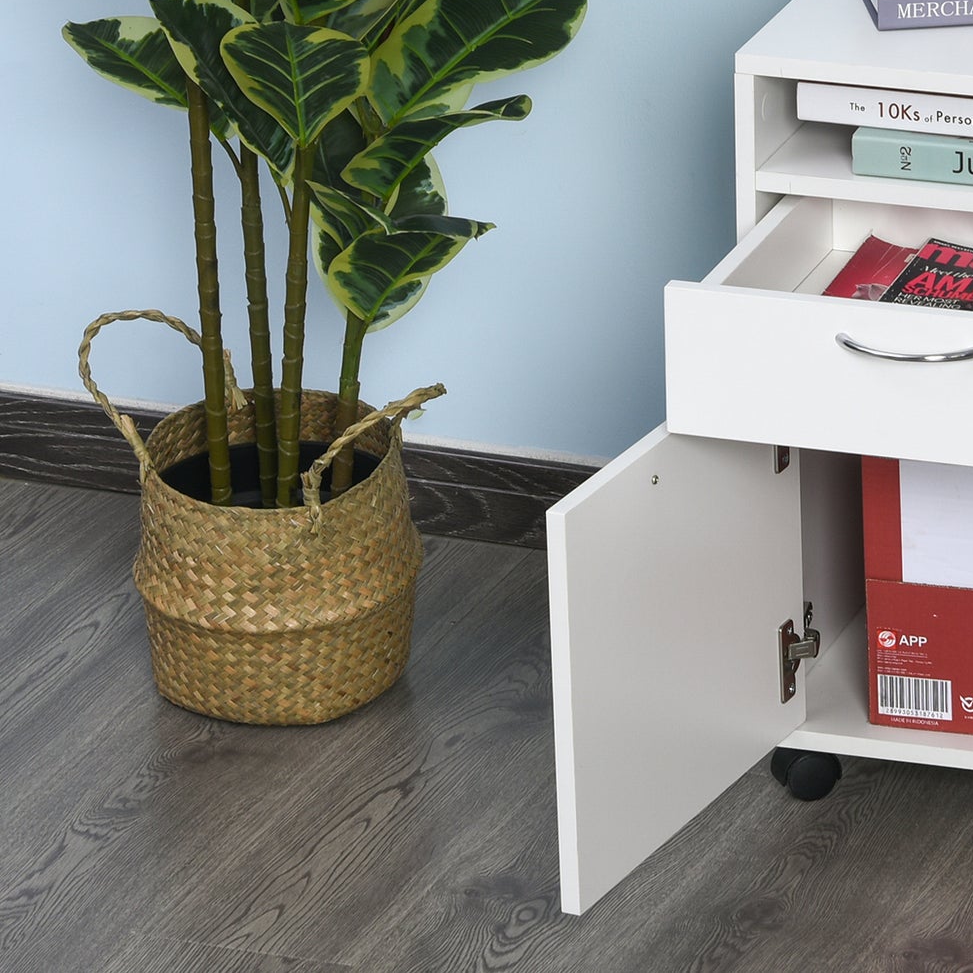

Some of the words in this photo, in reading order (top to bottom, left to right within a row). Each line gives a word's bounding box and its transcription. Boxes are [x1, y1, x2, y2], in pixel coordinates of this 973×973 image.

[850, 102, 866, 112] The
[878, 102, 921, 122] 10Ks
[924, 114, 934, 123] of
[897, 292, 924, 301] HER
[922, 296, 961, 305] MOST
[899, 634, 928, 648] APP
